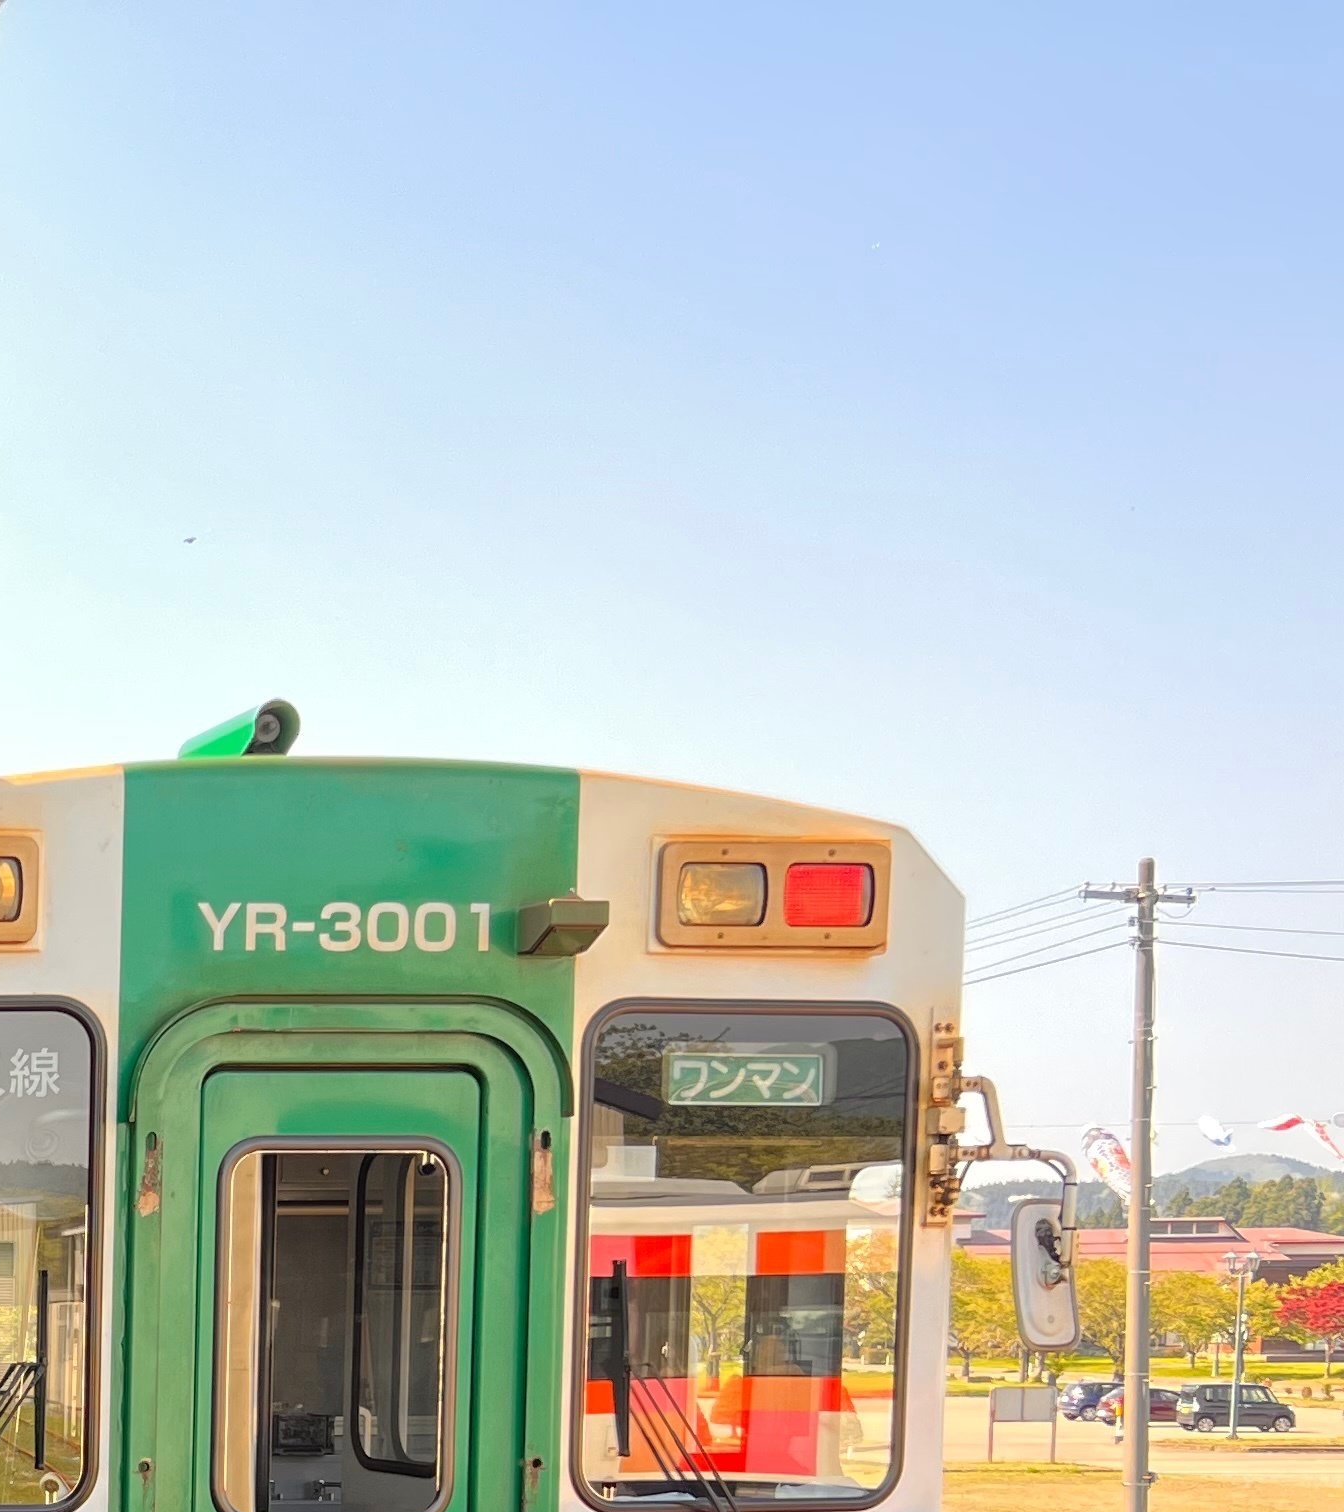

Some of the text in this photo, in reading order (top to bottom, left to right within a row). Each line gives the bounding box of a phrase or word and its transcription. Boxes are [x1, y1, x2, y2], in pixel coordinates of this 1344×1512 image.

[198, 902, 490, 952] YR-3001
[673, 1060, 816, 1100] ワンマン
